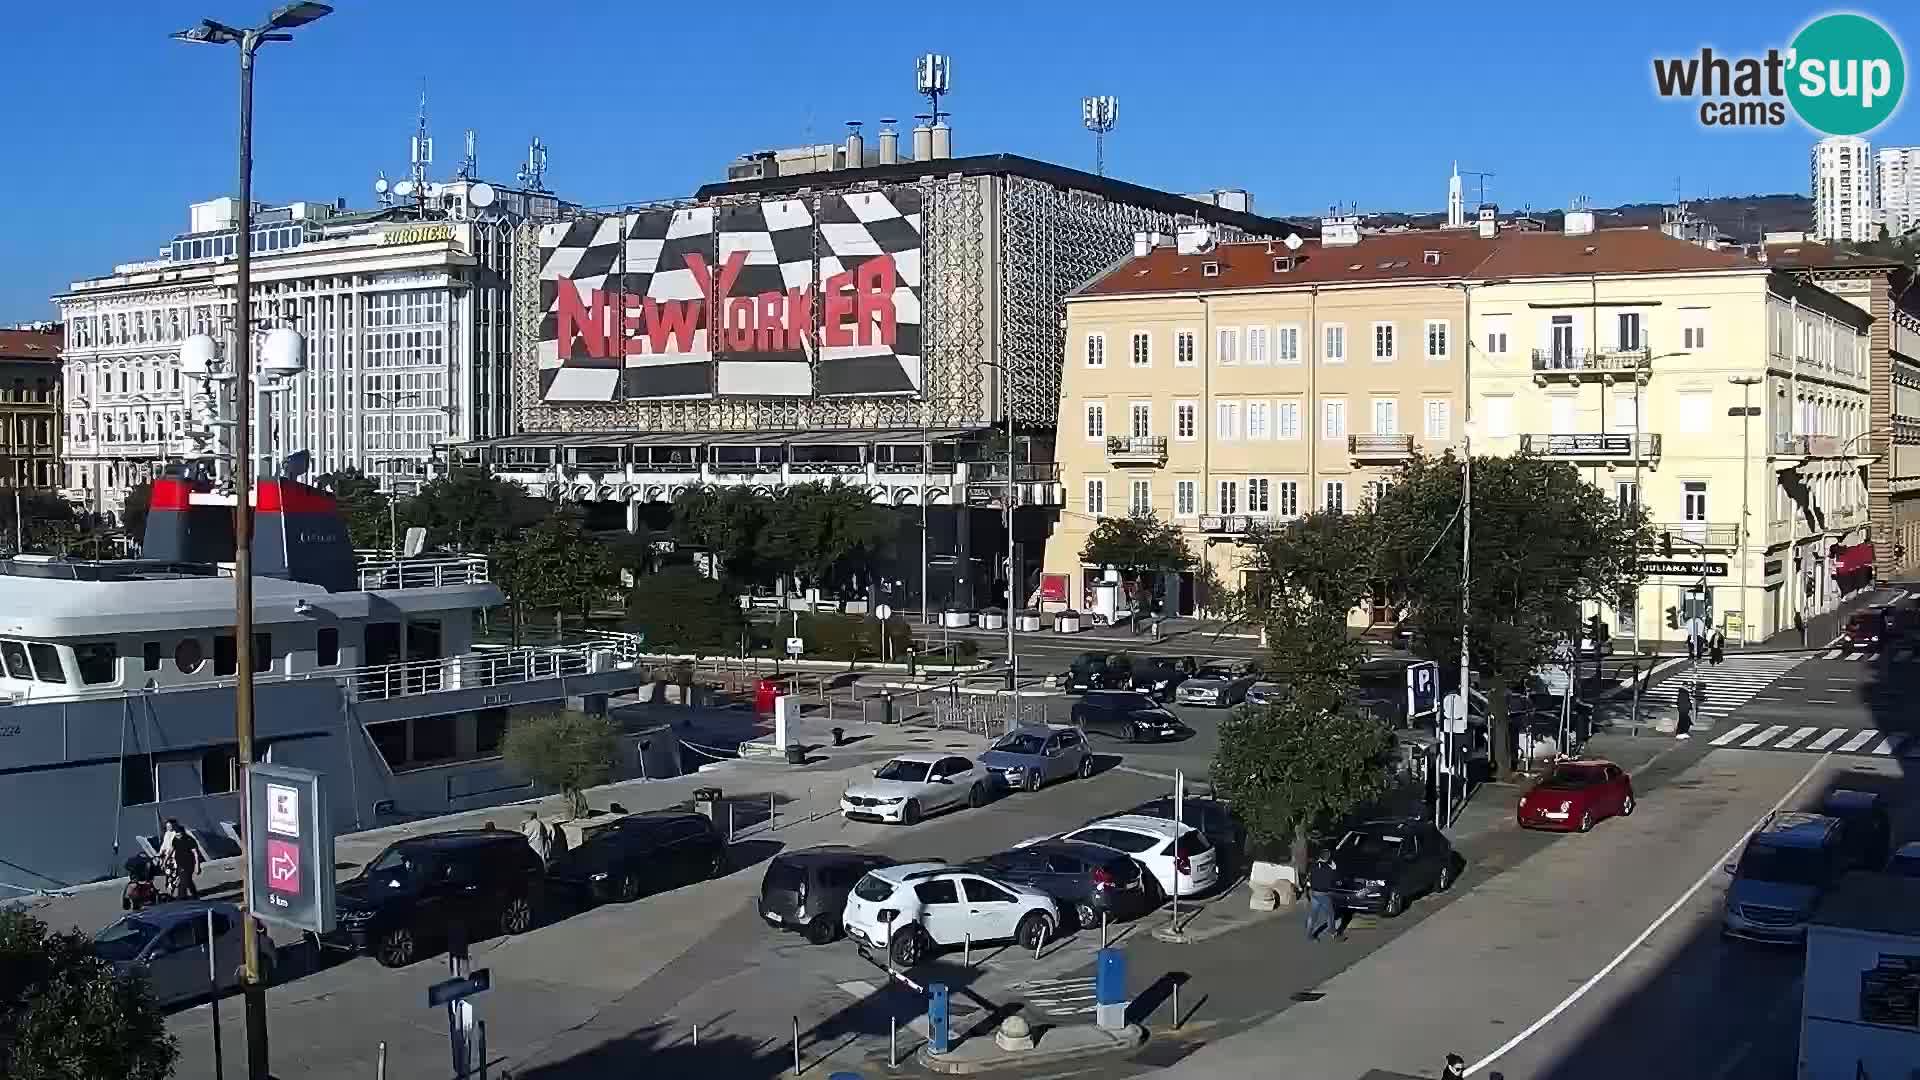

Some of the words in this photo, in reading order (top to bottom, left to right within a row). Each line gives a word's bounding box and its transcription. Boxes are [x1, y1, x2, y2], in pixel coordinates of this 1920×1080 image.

[557, 273, 702, 361] NEW
[681, 249, 897, 352] YORKER
[1642, 564, 1687, 573] JULIANA
[1691, 565, 1723, 574] NAILS
